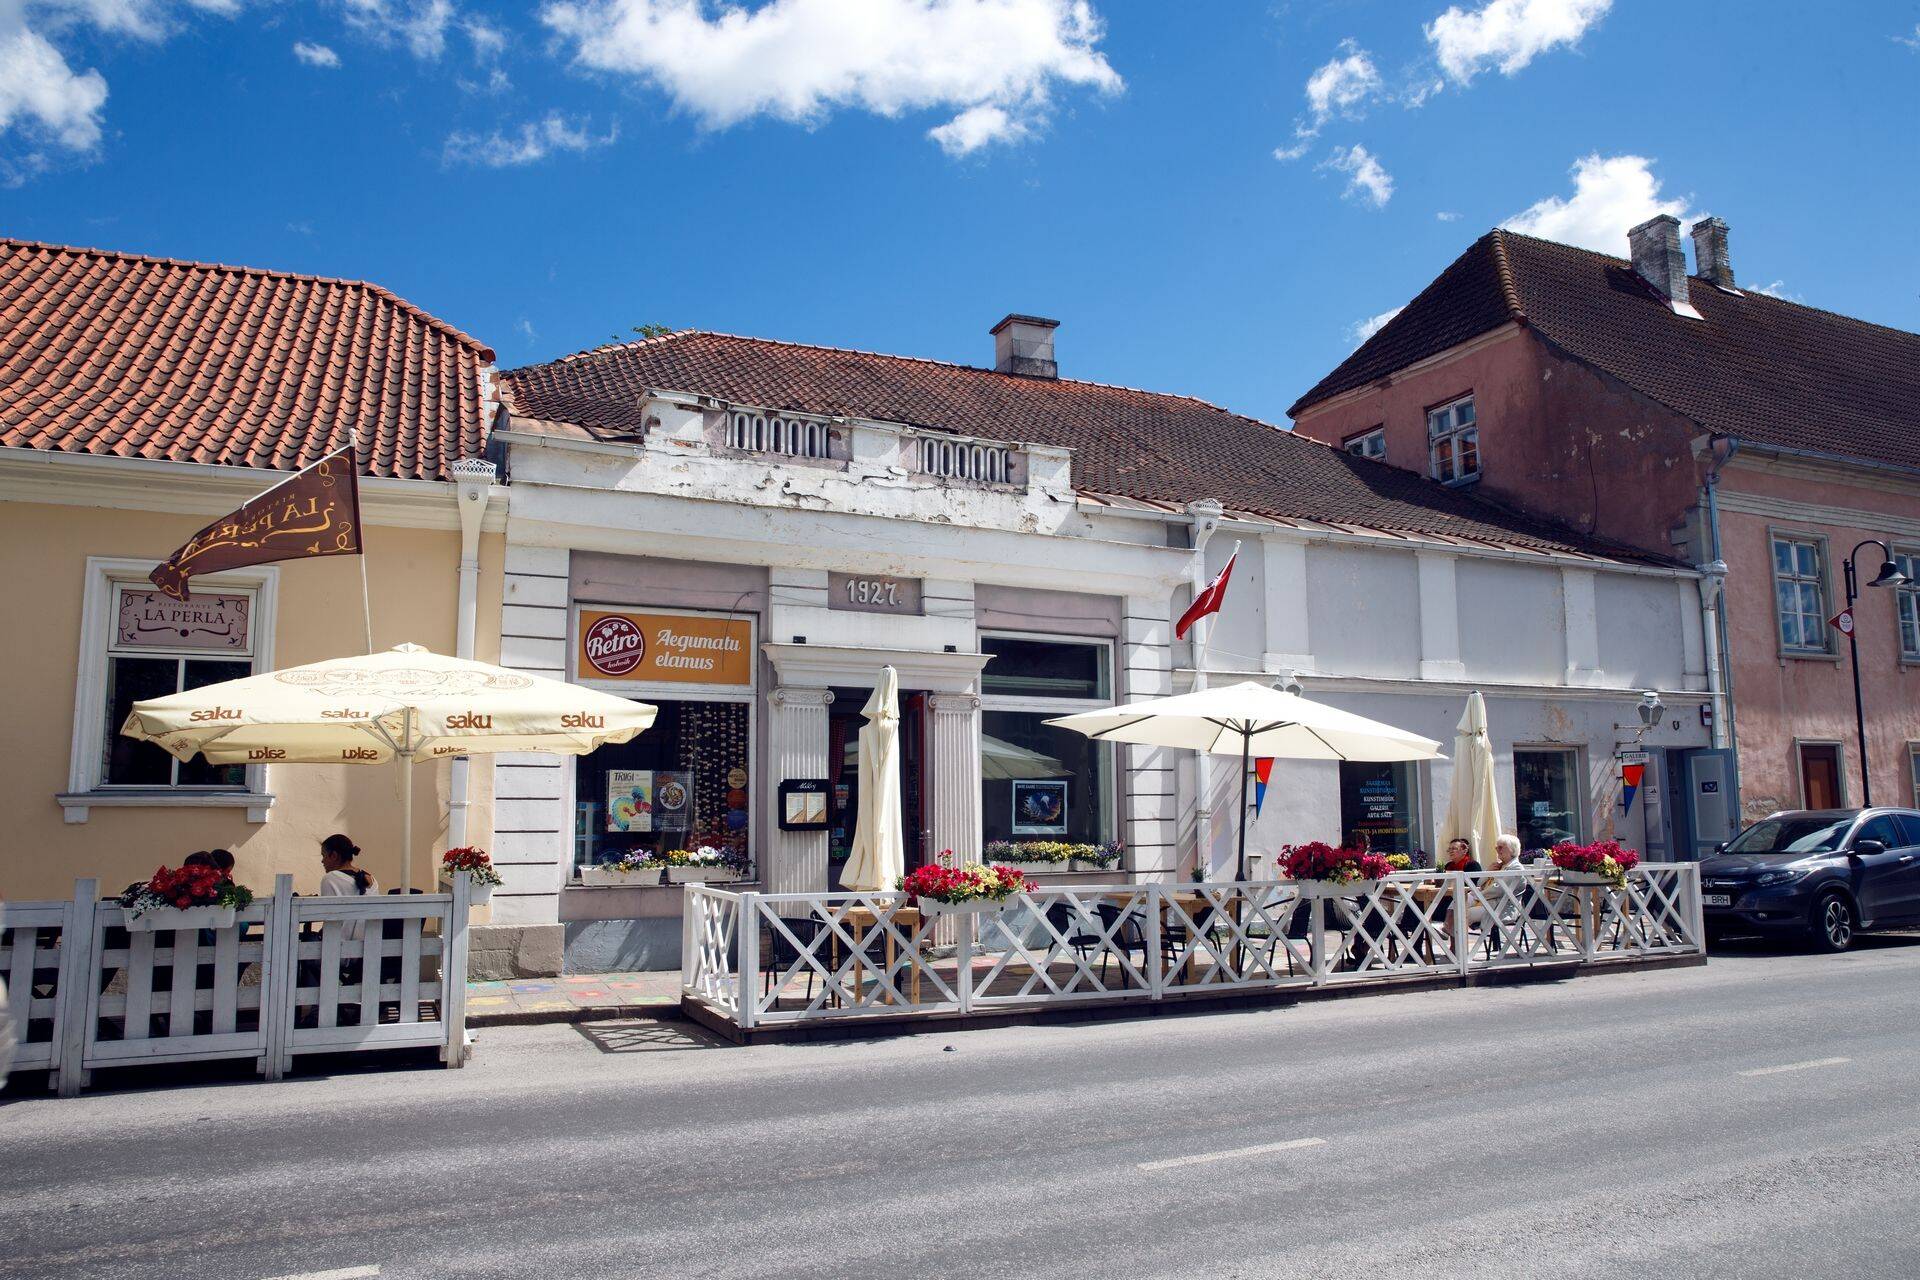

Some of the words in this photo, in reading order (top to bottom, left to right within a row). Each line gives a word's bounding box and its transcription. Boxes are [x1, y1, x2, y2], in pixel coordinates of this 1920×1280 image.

[145, 609, 165, 621] LA
[172, 610, 225, 624] PERLA
[588, 632, 640, 657] Retro
[655, 629, 742, 652] Aegumatu
[655, 651, 714, 670] elamus
[189, 706, 242, 722] saku
[320, 708, 369, 719] saku
[446, 710, 492, 729] saku
[561, 710, 604, 728] saku
[1711, 895, 1729, 904] BRH
